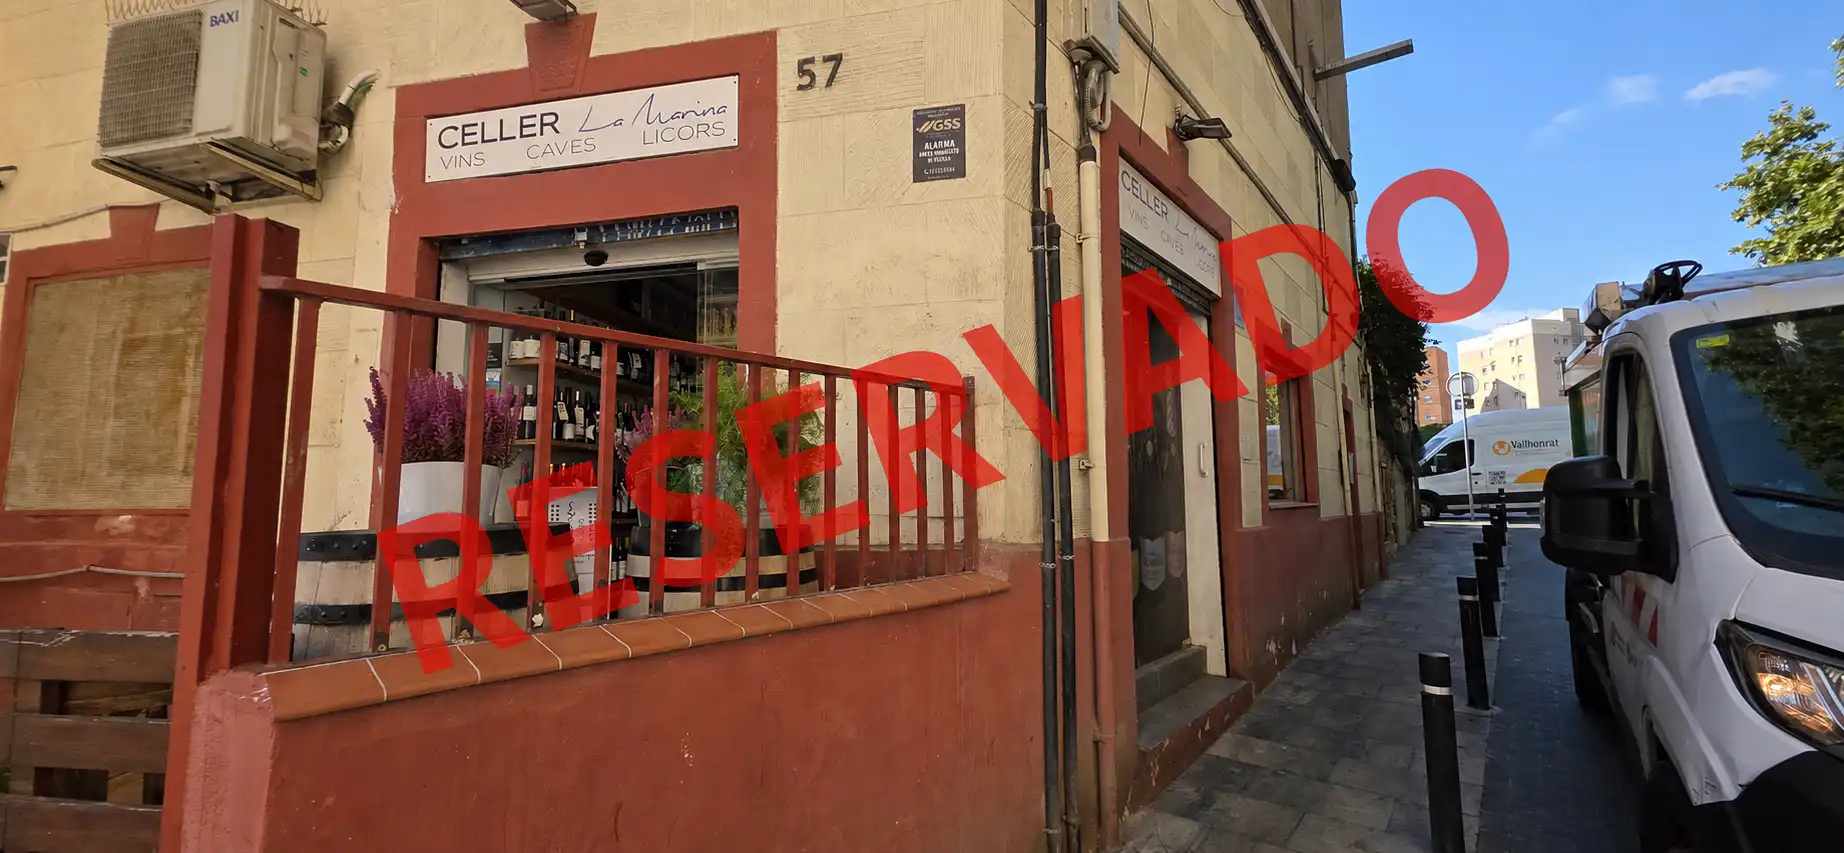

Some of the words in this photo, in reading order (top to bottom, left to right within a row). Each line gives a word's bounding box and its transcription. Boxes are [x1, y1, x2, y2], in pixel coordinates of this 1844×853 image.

[210, 10, 239, 27] BAXI
[796, 52, 844, 91] 57
[438, 112, 561, 150] CELLER
[578, 104, 624, 133] La
[631, 93, 729, 127] Marina
[933, 118, 961, 131] GSS
[440, 152, 487, 171] VINS
[526, 138, 597, 160] CAVES
[642, 121, 727, 147] LICORS
[925, 140, 955, 150] ALARMA
[1121, 170, 1170, 225] CELLER
[1128, 204, 1149, 230] VINS
[1511, 439, 1559, 449] Vallhonrat
